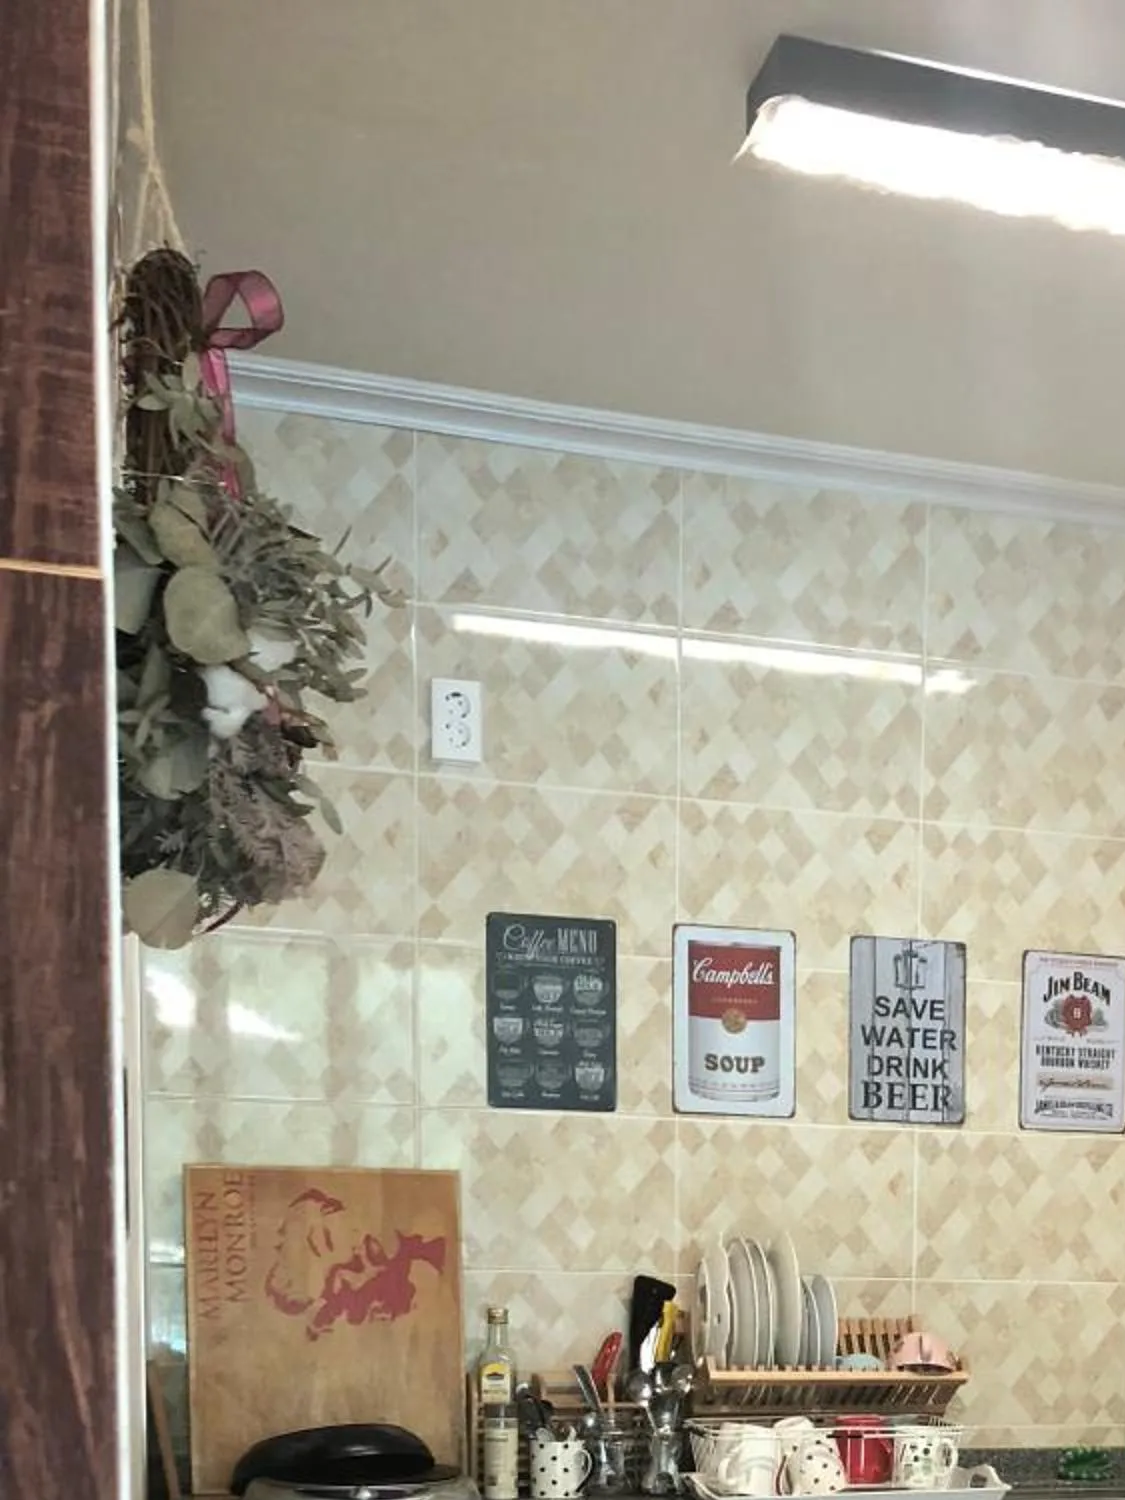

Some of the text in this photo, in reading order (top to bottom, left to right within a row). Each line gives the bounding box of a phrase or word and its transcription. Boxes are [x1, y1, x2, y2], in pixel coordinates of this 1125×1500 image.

[557, 927, 598, 953] MENU
[1073, 971, 1111, 1007] BEAM
[873, 995, 945, 1021] SAVE
[861, 1024, 957, 1051] WATER
[704, 1053, 766, 1075] SOUP
[867, 1055, 949, 1079] DRINK
[861, 1079, 953, 1112] BEER
[222, 1170, 251, 1304] MONROE
